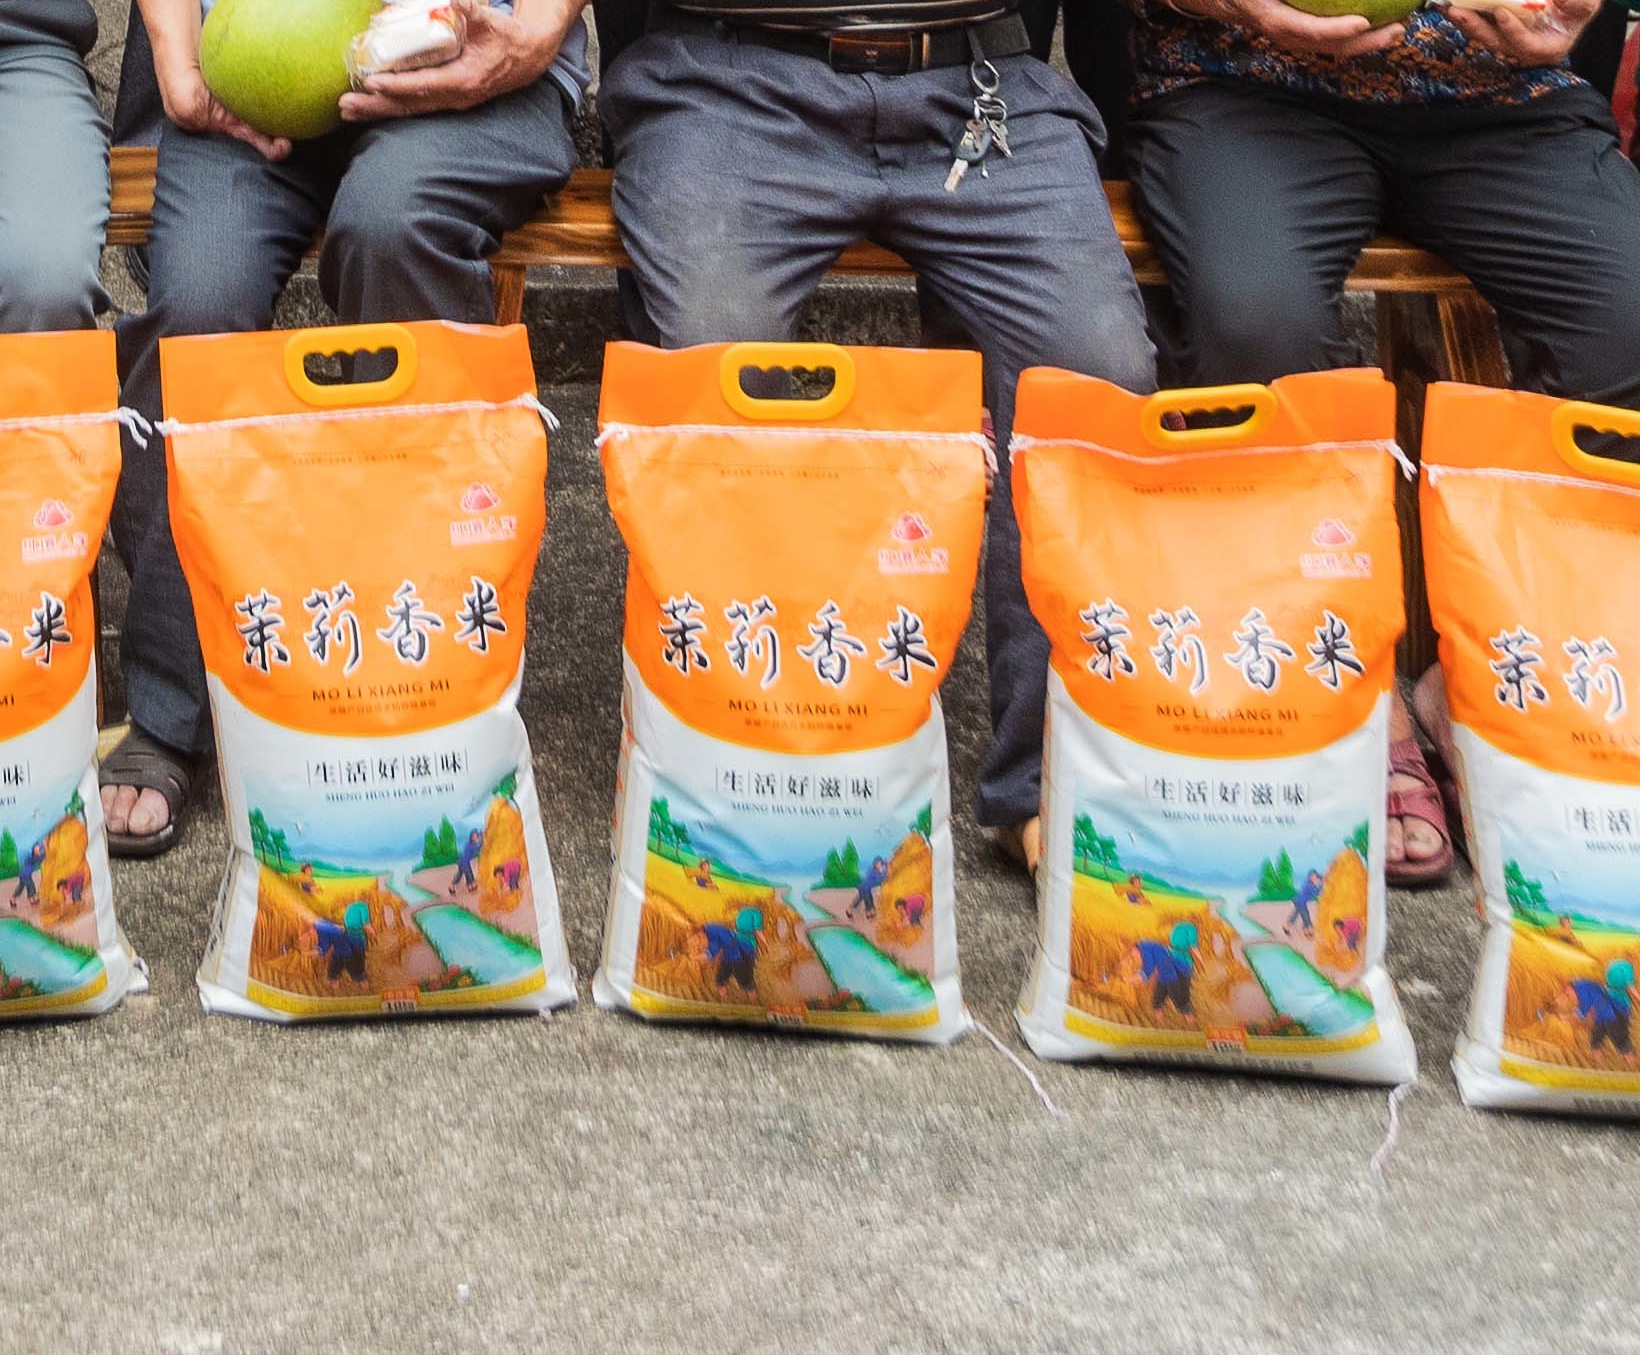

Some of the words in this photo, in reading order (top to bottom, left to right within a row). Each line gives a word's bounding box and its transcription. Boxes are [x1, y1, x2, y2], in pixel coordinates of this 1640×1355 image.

[235, 576, 507, 677] 茉莉香米
[658, 591, 938, 691] 茉莉香米
[1077, 597, 1366, 696] 茉莉香米
[312, 688, 340, 702] MO
[346, 686, 362, 701] LI
[369, 682, 423, 697] XIANG
[429, 679, 451, 691] MI
[728, 699, 757, 713] MO
[764, 701, 780, 714] LI
[783, 701, 842, 717] XIANG
[847, 704, 869, 717] MI
[314, 750, 464, 784] 生活好滋味
[721, 769, 873, 800] 生活好滋味
[1152, 777, 1305, 807] 生活好滋味
